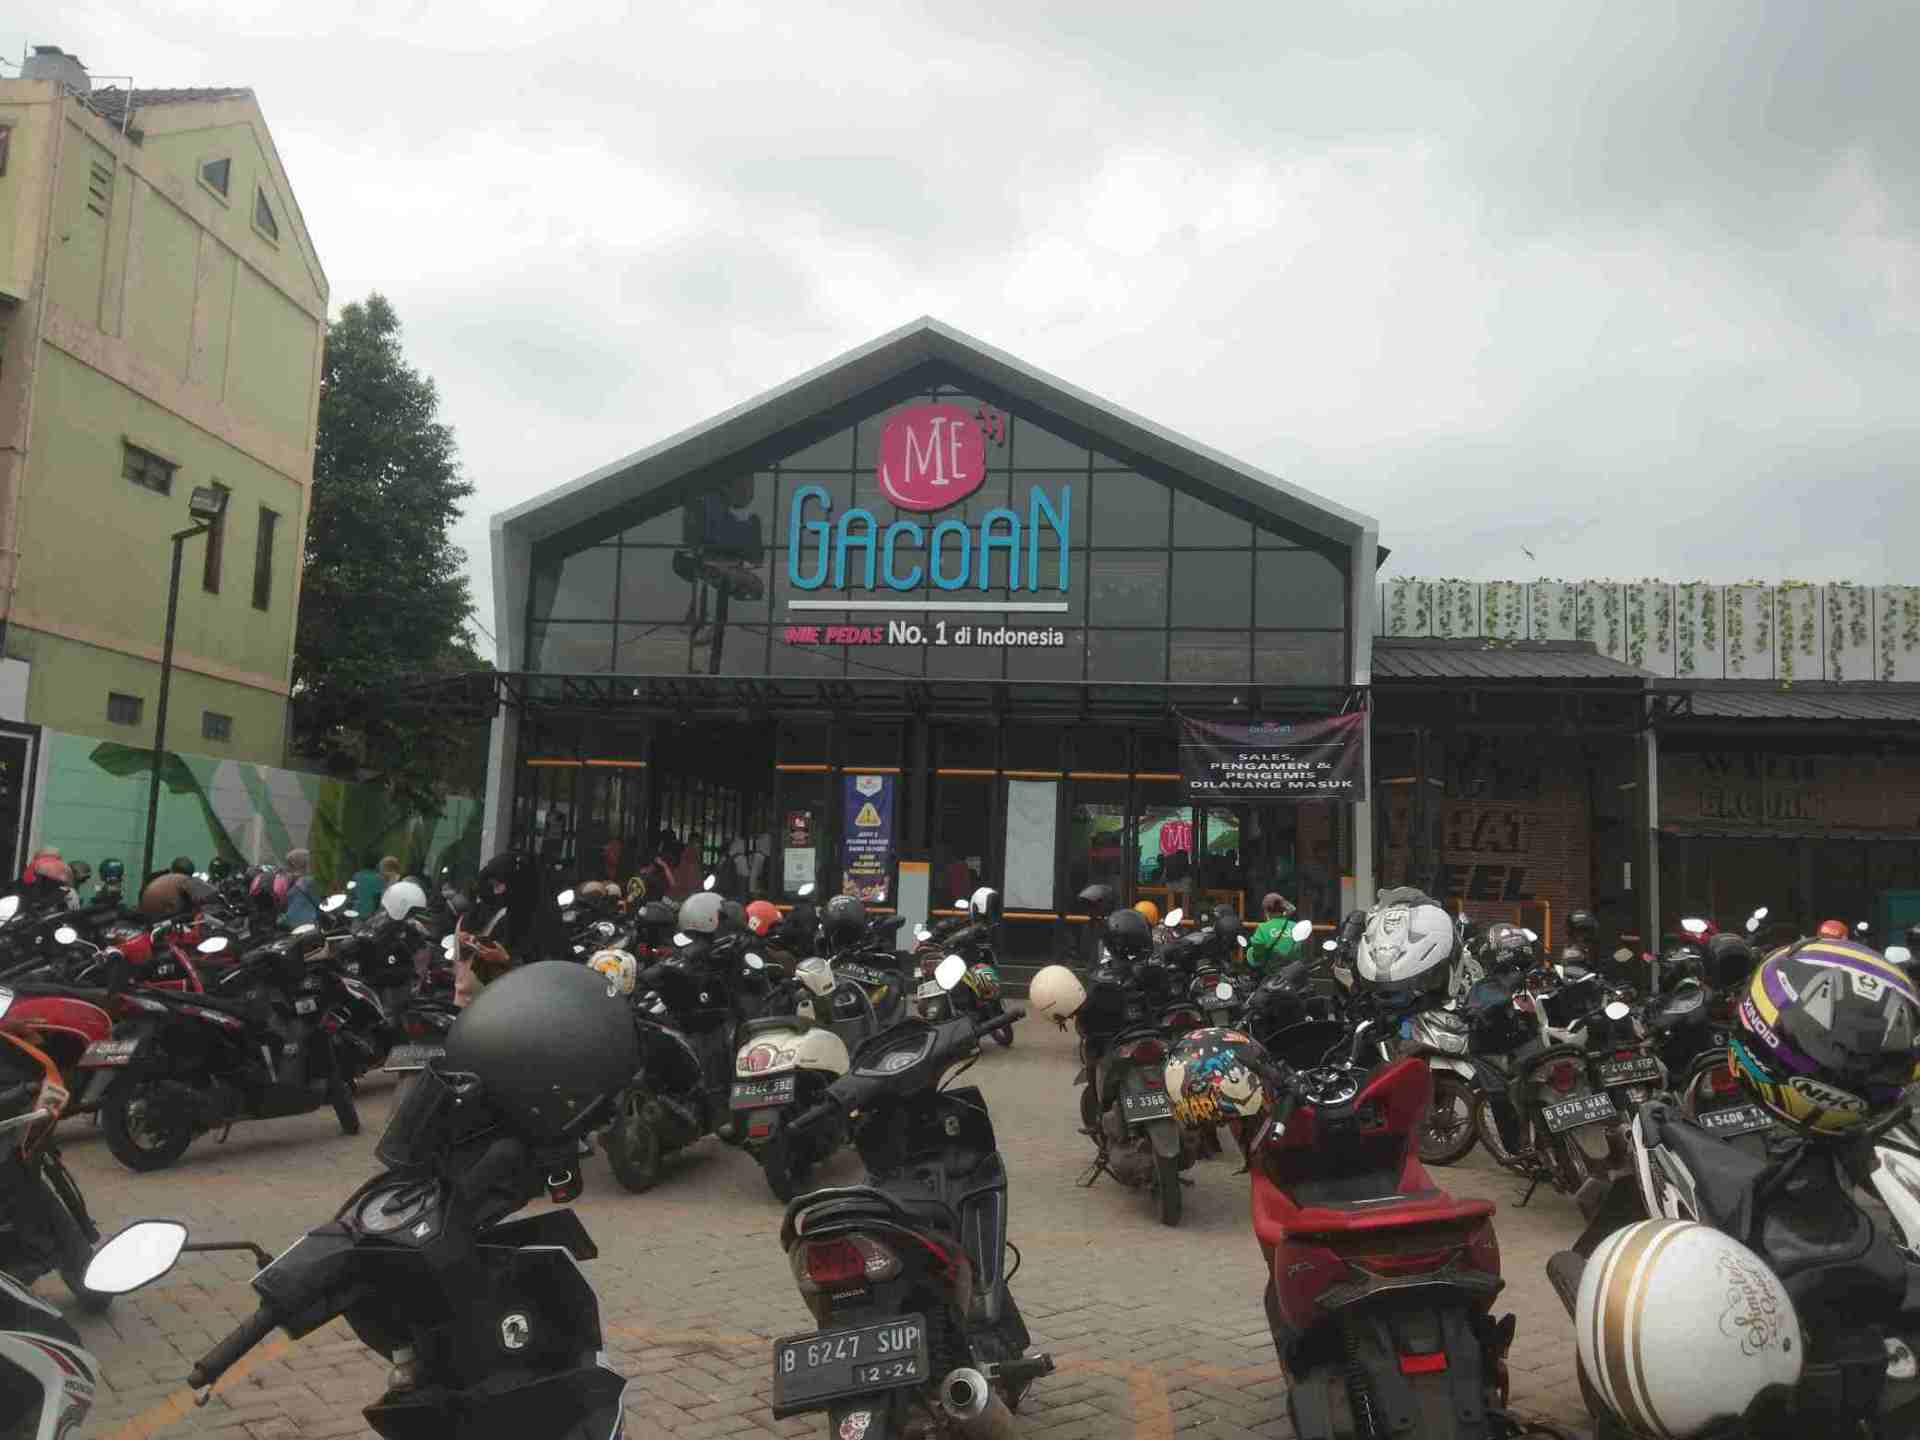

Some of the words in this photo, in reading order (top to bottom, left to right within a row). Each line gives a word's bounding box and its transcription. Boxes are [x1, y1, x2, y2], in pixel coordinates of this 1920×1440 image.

[788, 485, 1072, 592] GACOAN
[825, 625, 883, 645] PEDAS
[888, 620, 928, 645] No.
[936, 620, 948, 645] 1
[954, 626, 972, 645] di
[977, 627, 1064, 646] Indonesia
[1210, 762, 1310, 770] PENGAMEN
[1225, 771, 1317, 780] PENGEMIS
[1190, 780, 1282, 789] DILARANG
[1287, 780, 1353, 789] MASUK
[784, 1349, 795, 1373] B
[807, 1335, 860, 1367] 6247
[877, 1326, 917, 1353] SUP
